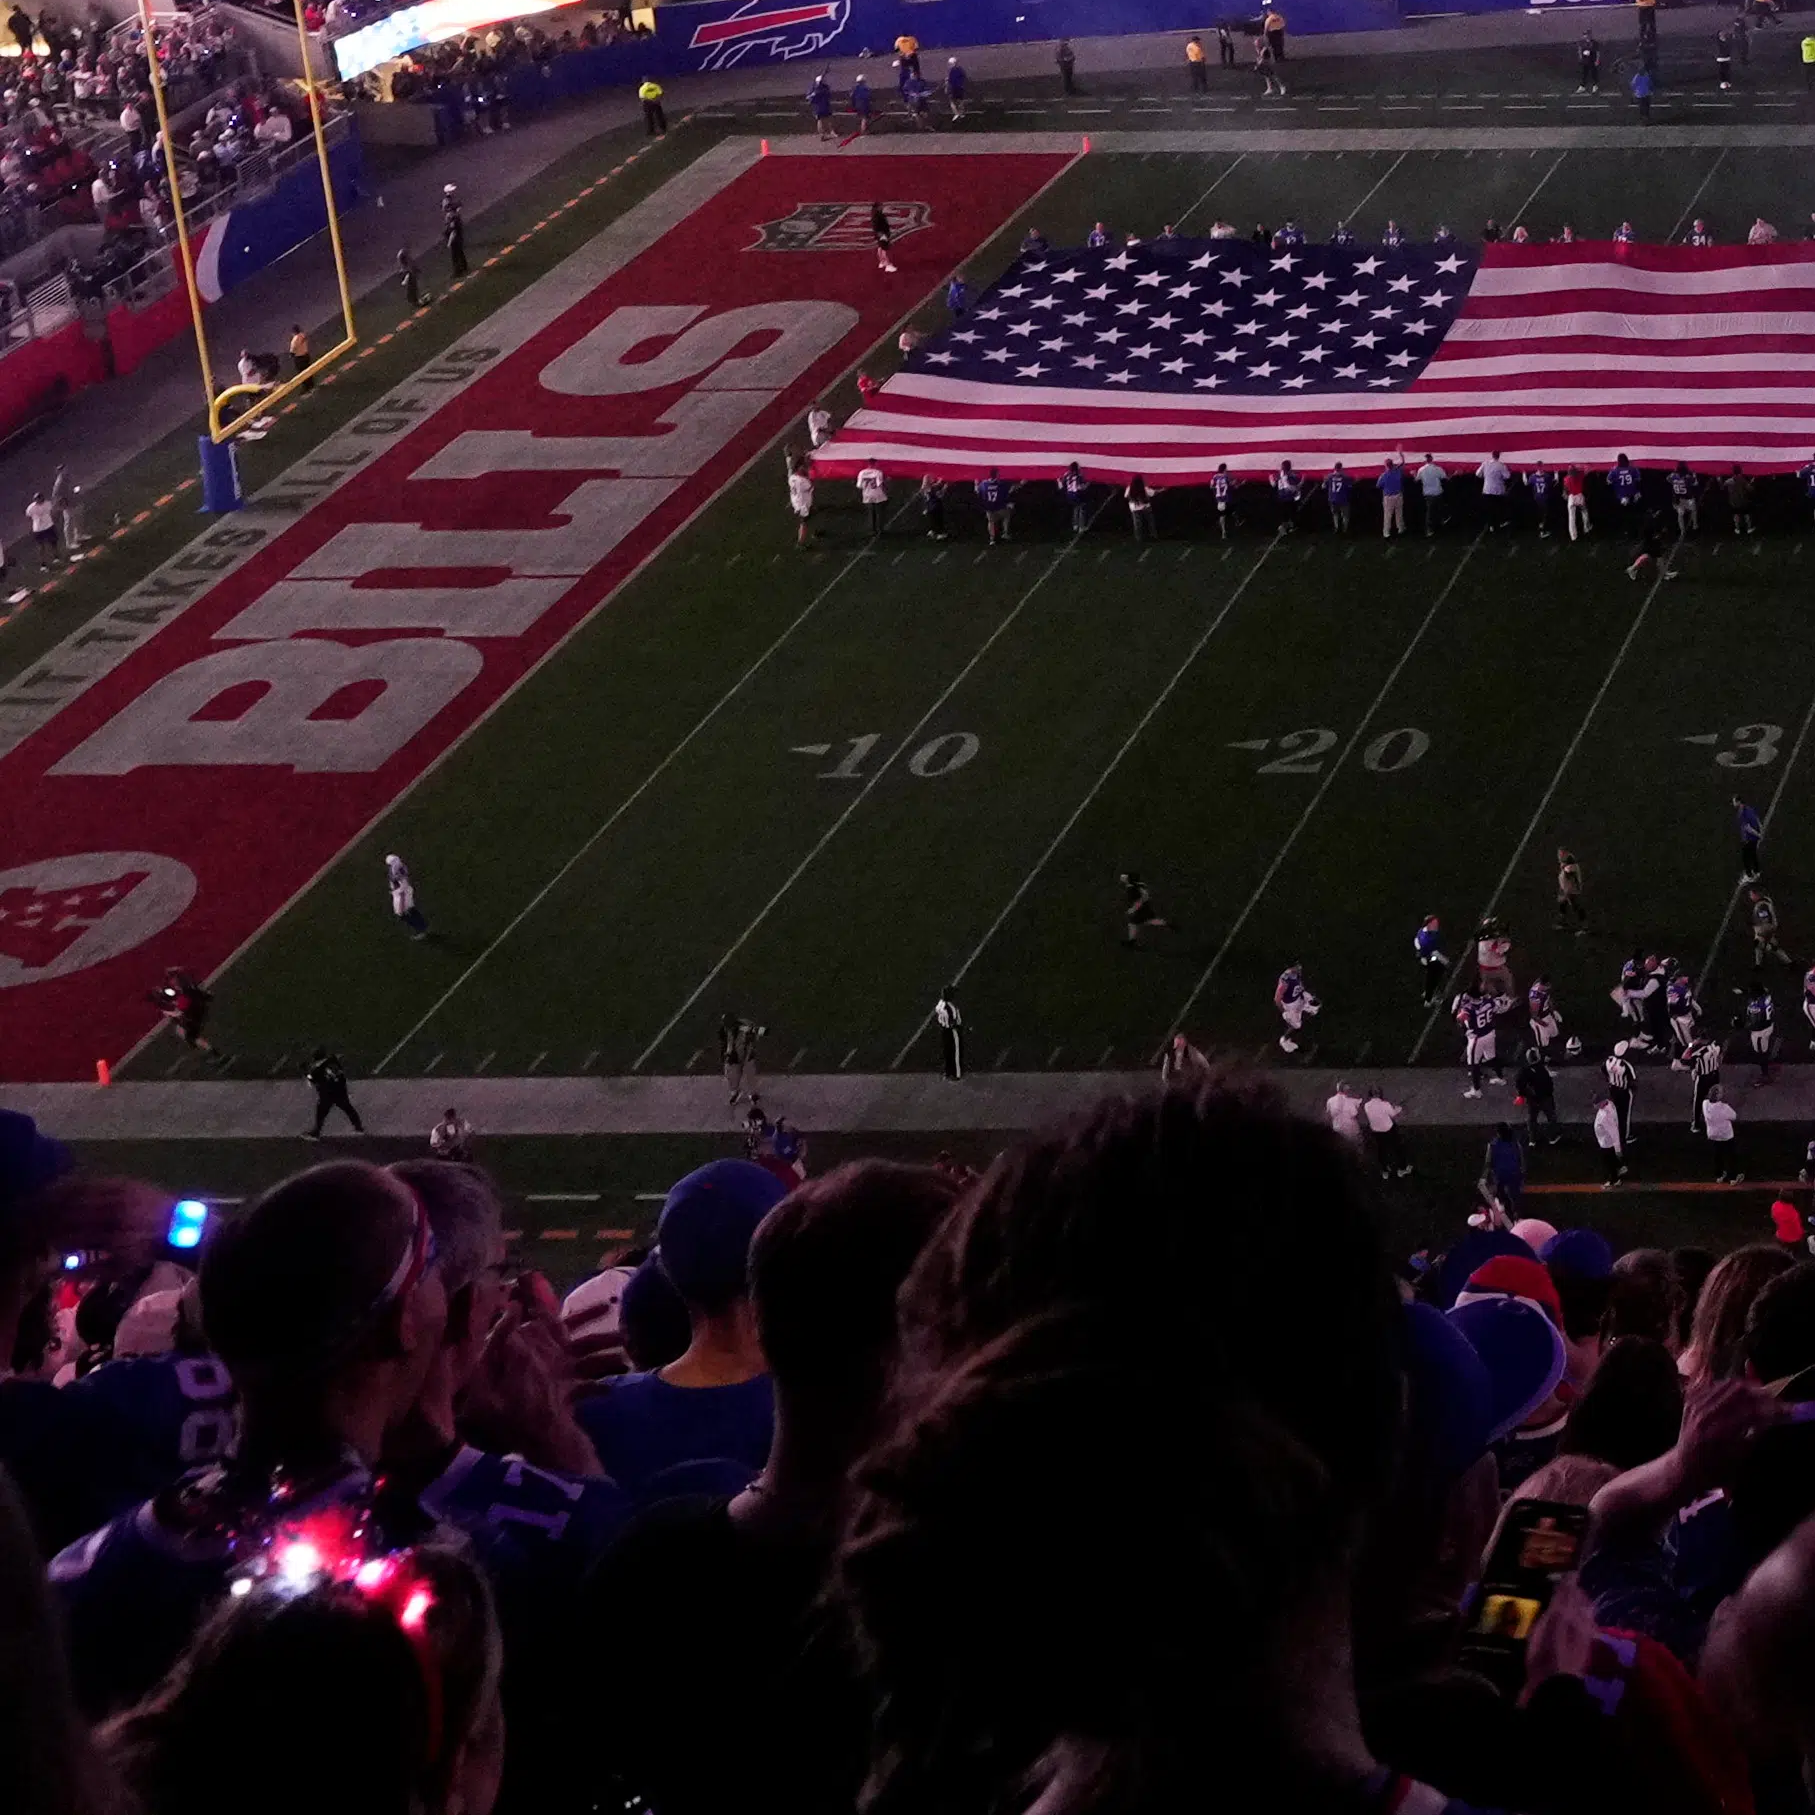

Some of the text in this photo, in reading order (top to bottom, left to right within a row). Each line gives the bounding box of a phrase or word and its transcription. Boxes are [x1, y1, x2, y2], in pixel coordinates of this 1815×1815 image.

[44, 299, 861, 776] BILLS
[75, 524, 267, 649] TAKES
[351, 396, 428, 439] OF
[425, 345, 501, 383] US
[817, 730, 980, 779] 10
[1256, 725, 1432, 776] 20
